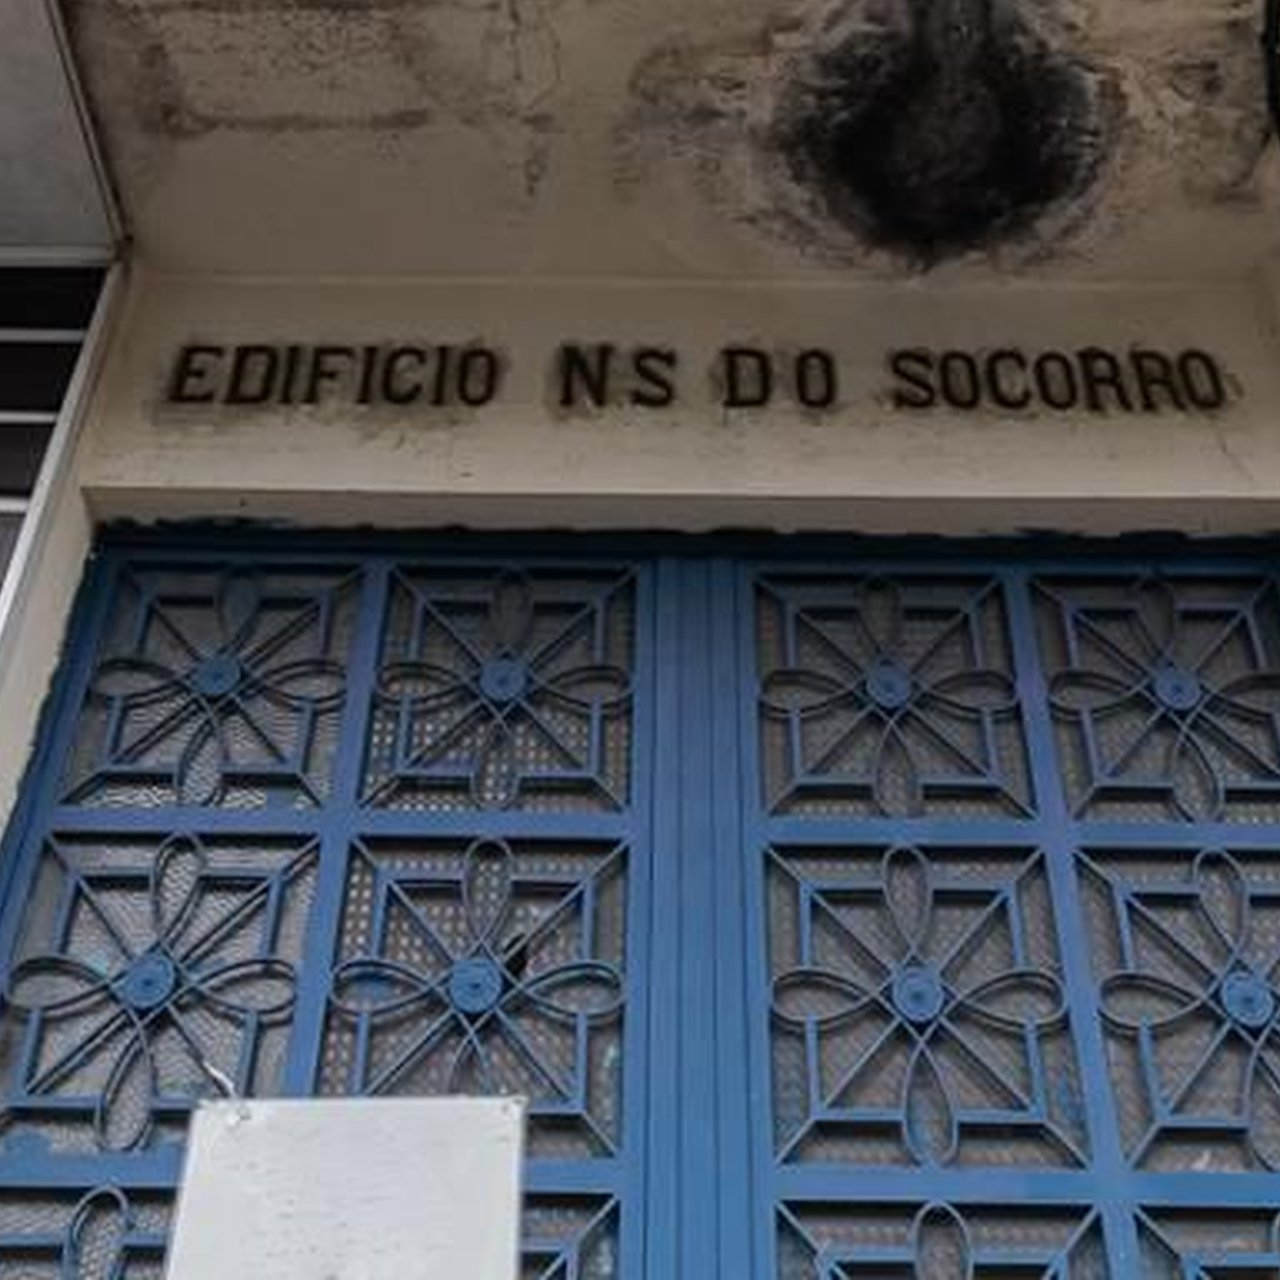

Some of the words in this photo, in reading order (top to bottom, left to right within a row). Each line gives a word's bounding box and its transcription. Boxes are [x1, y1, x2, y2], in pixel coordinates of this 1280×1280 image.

[169, 345, 500, 407] EDIFICIO
[721, 348, 837, 408] DO
[890, 347, 1226, 410] SOCORRO
